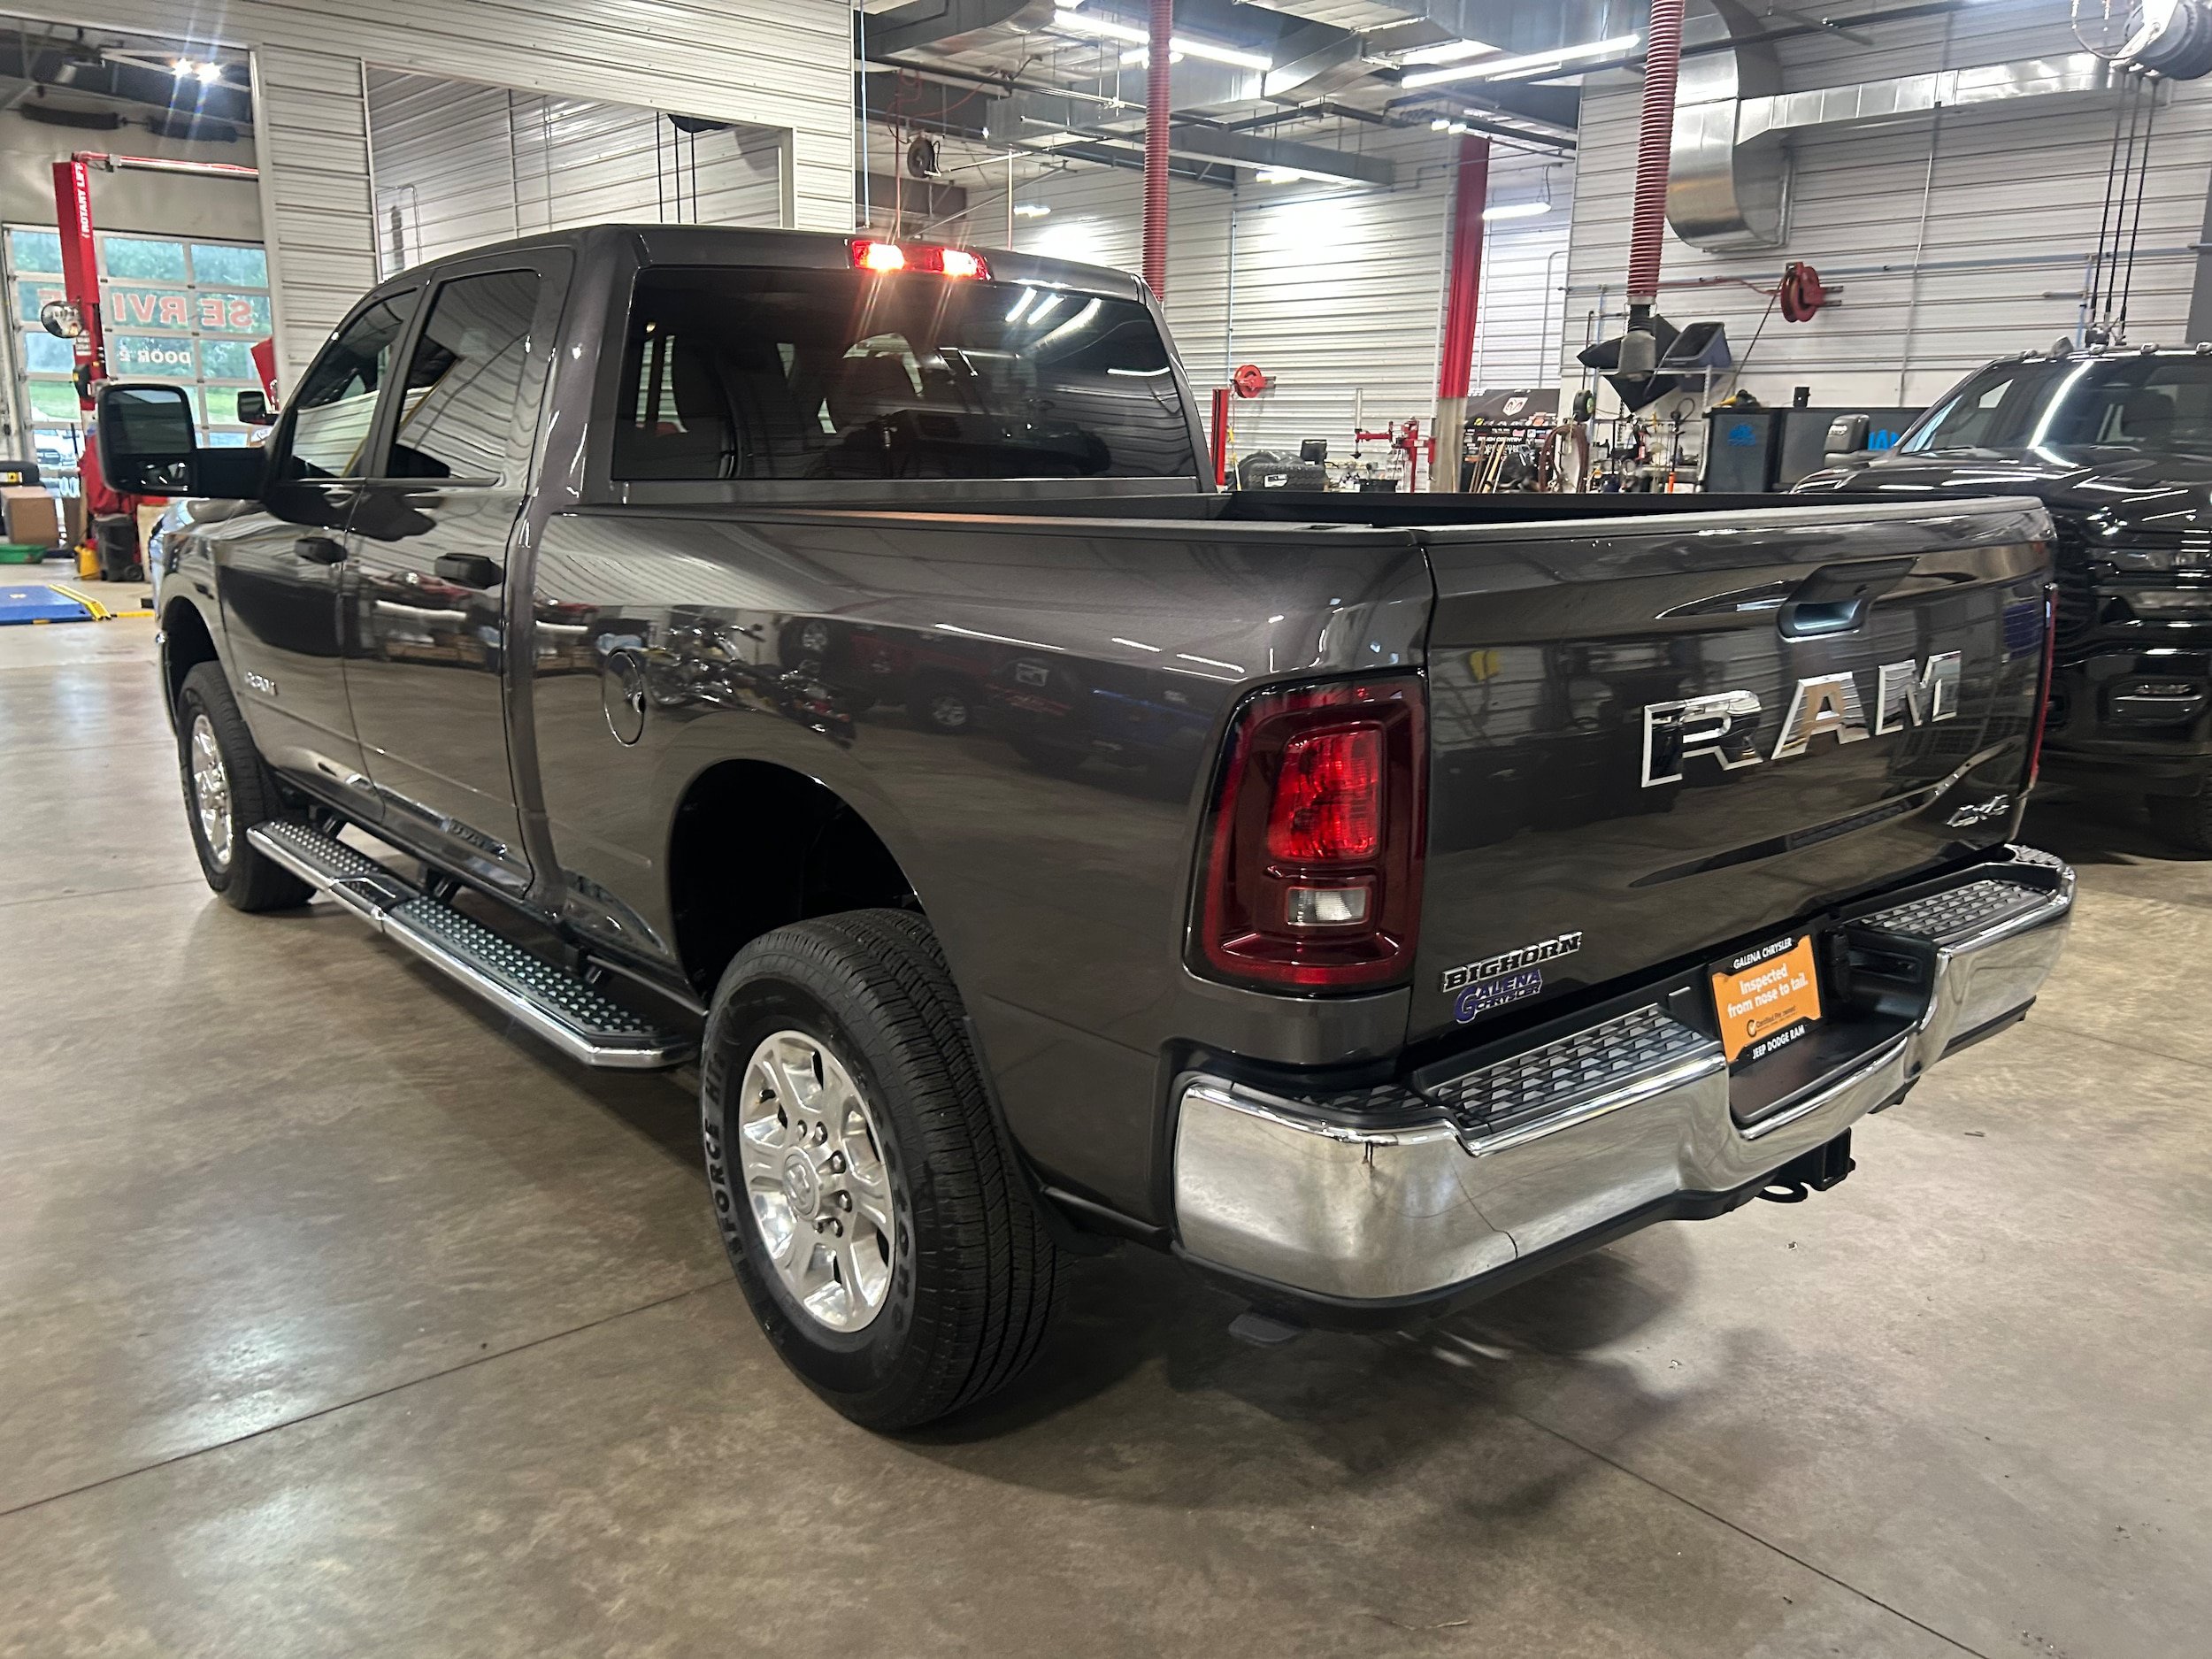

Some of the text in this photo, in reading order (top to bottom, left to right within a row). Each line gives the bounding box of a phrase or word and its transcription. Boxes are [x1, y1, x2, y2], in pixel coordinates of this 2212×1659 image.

[74, 162, 90, 233] ROTARY LIFT
[1641, 649, 1962, 788] RAM
[1441, 931, 1583, 993] BIGHORN
[1733, 937, 1793, 970] GALENA CHRYSLER
[1740, 962, 1789, 995] Inspected
[1454, 969, 1543, 1024] GALENA
[1727, 999, 1754, 1018] from
[1755, 988, 1778, 1007] nose
[1778, 983, 1790, 996] to
[1790, 972, 1809, 991] tail.
[1752, 1024, 1806, 1060] JEEP DODGE RAM
